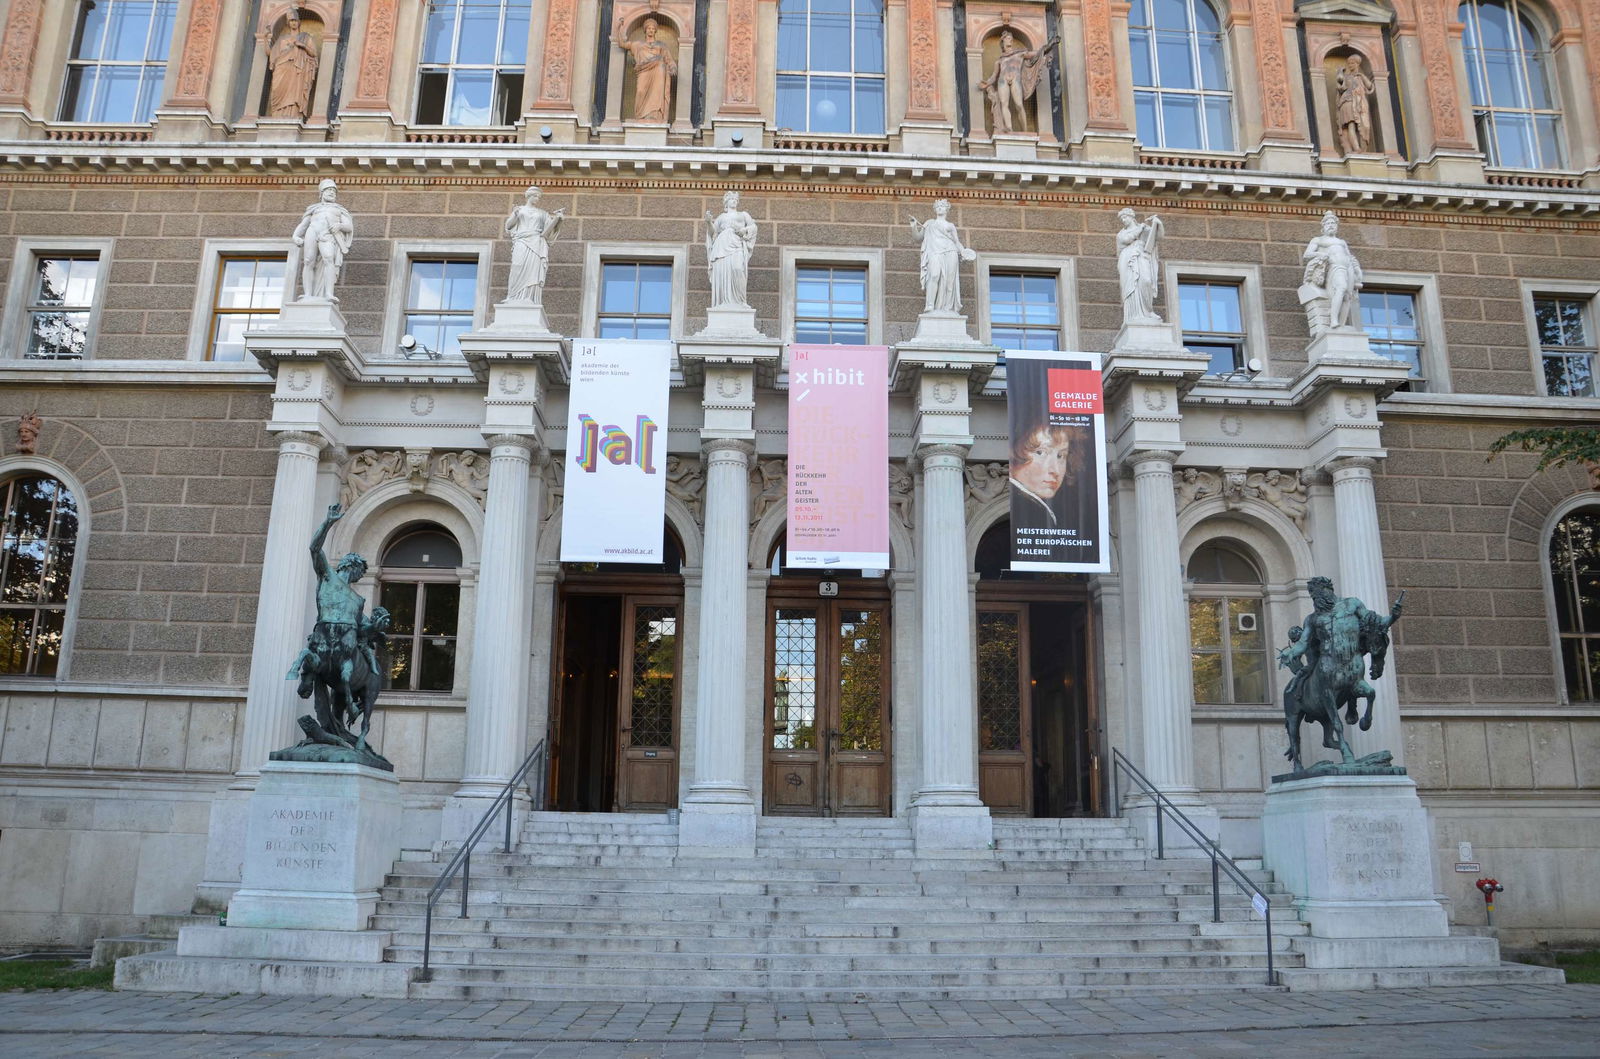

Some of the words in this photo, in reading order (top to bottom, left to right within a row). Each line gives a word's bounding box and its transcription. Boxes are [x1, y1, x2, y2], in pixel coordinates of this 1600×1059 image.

[1054, 392, 1098, 400] GEMÄLDE
[1054, 401, 1093, 409] GALERIE
[1016, 528, 1076, 536] MEISTERWERKE
[1035, 538, 1092, 546] EUROPÄISCHEN
[825, 582, 832, 591] 3
[271, 809, 335, 820] AKADEMIE
[290, 826, 314, 836] DER
